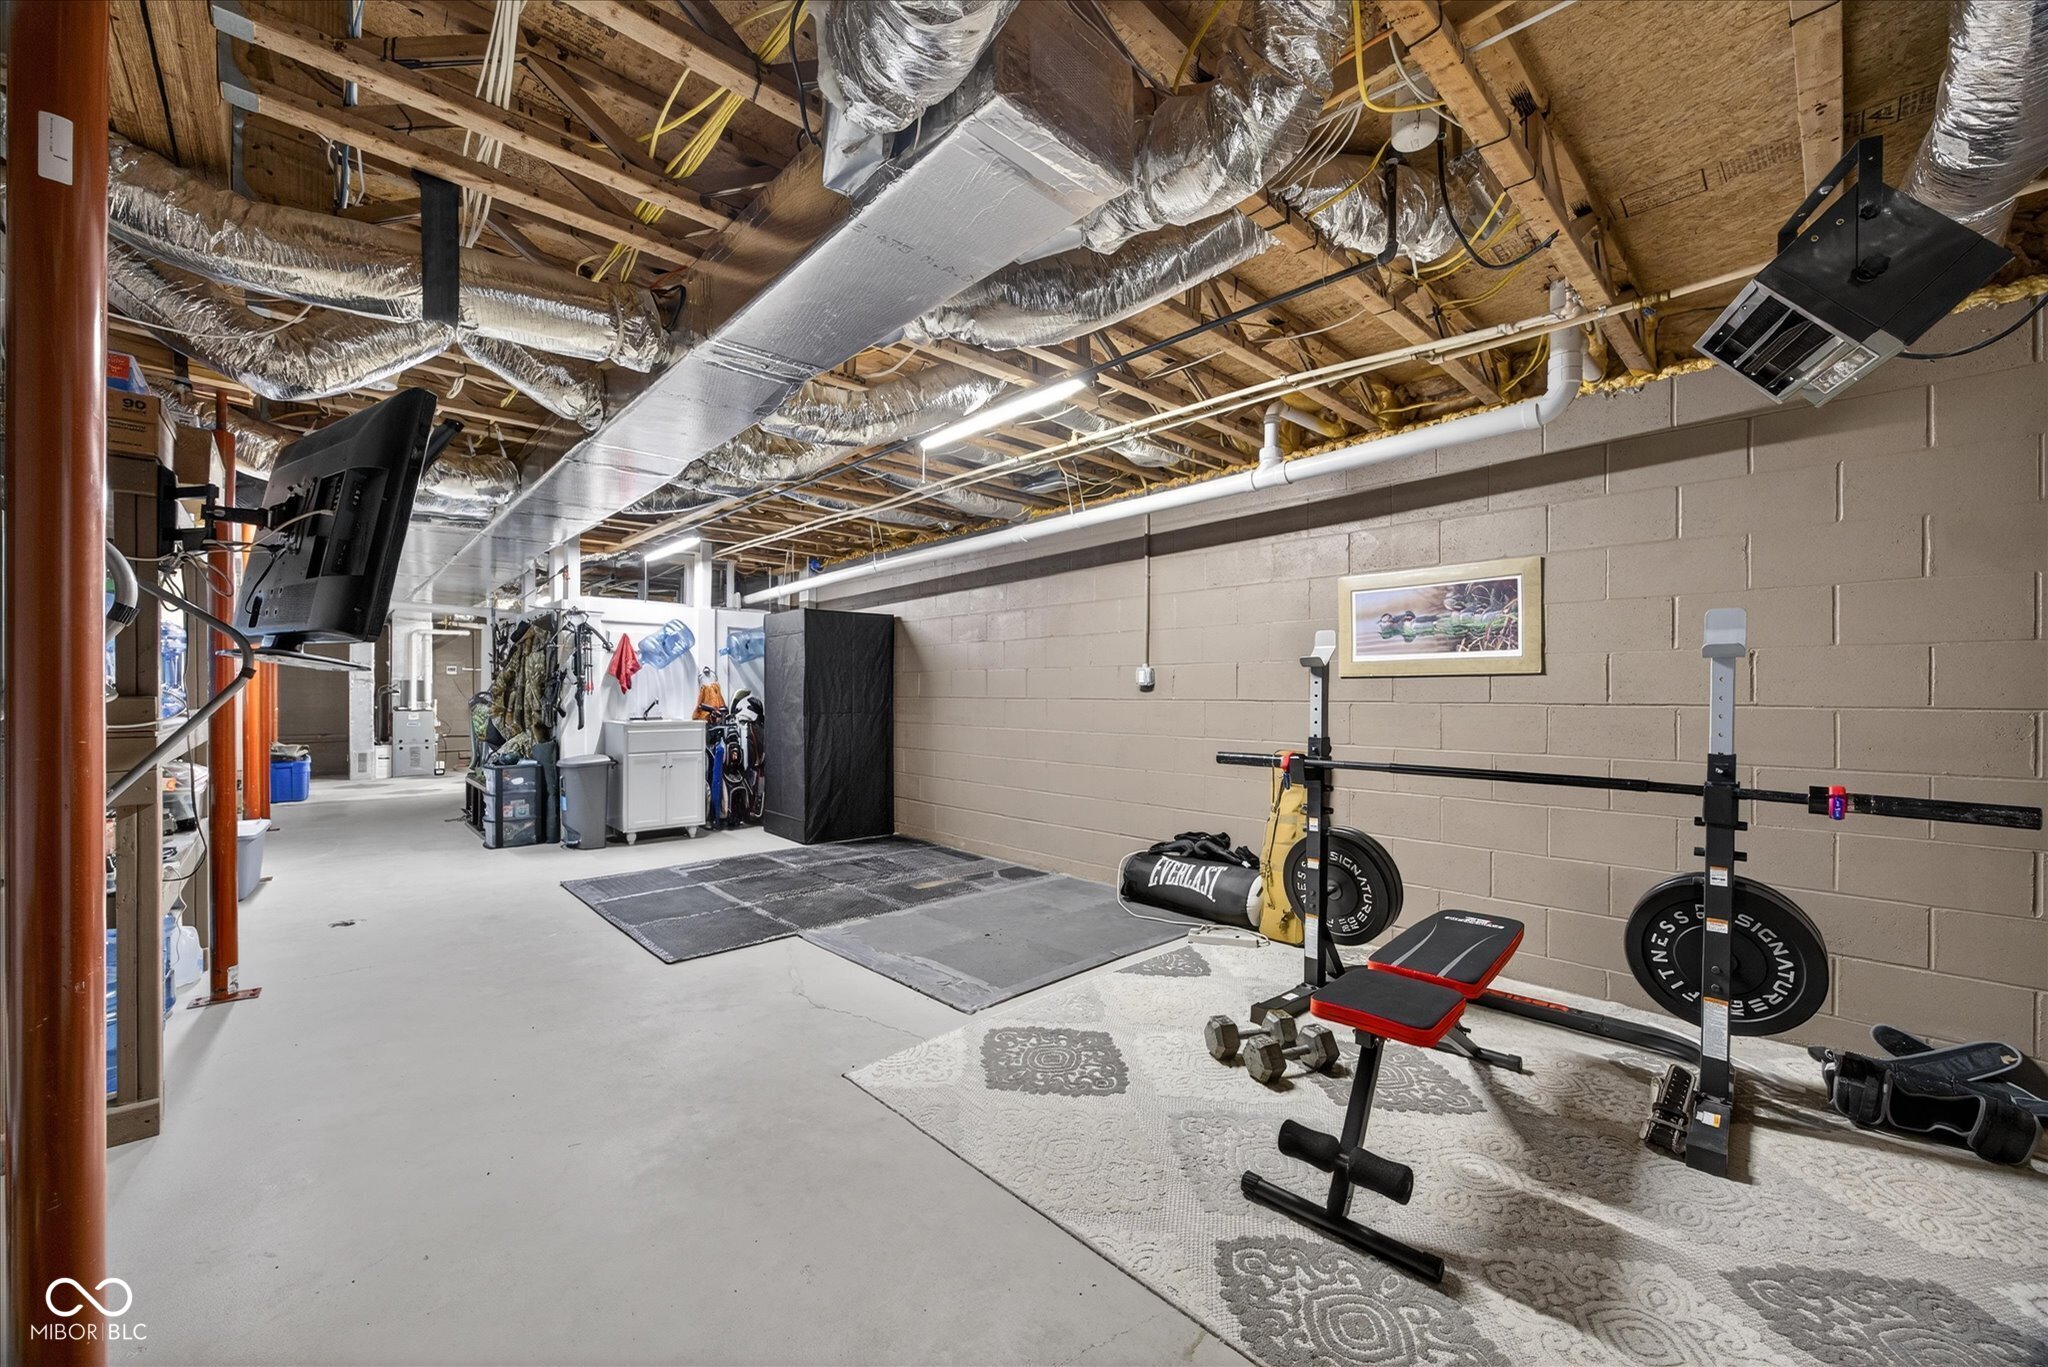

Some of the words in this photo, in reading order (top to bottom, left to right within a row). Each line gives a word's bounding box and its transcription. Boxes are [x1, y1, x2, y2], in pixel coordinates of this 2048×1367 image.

[1148, 855, 1229, 900] EVERLAST
[1329, 851, 1373, 923] SIGNATURE
[1651, 911, 1701, 1002] FITNESS
[1735, 913, 1796, 1013] SIGNATURE
